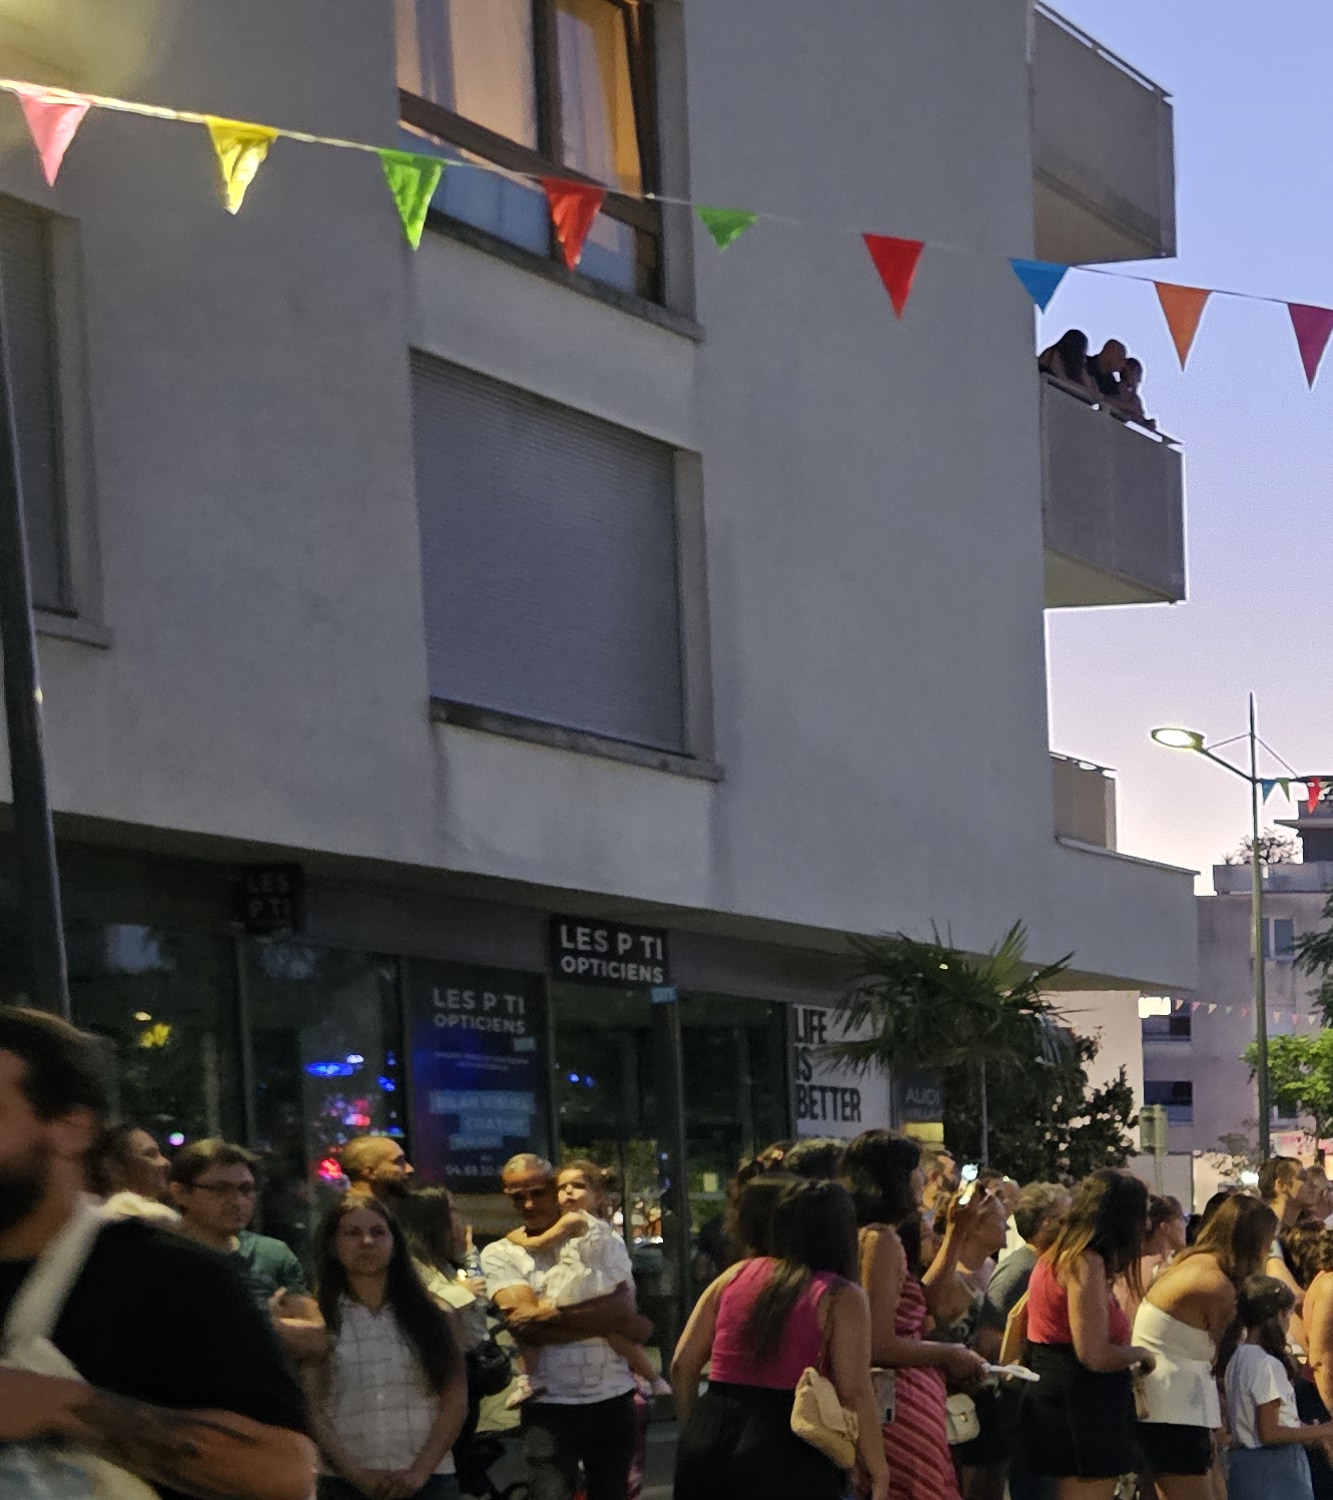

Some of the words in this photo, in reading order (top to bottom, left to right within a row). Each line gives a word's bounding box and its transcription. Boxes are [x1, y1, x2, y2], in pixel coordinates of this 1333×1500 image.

[560, 924, 609, 952] LES
[560, 955, 664, 984] OPTICIENS
[433, 988, 476, 1010] LES
[433, 1013, 525, 1034] OPTICIENS
[794, 1008, 827, 1044] LIFE
[795, 1046, 813, 1082] IS
[795, 1084, 861, 1122] BETTER
